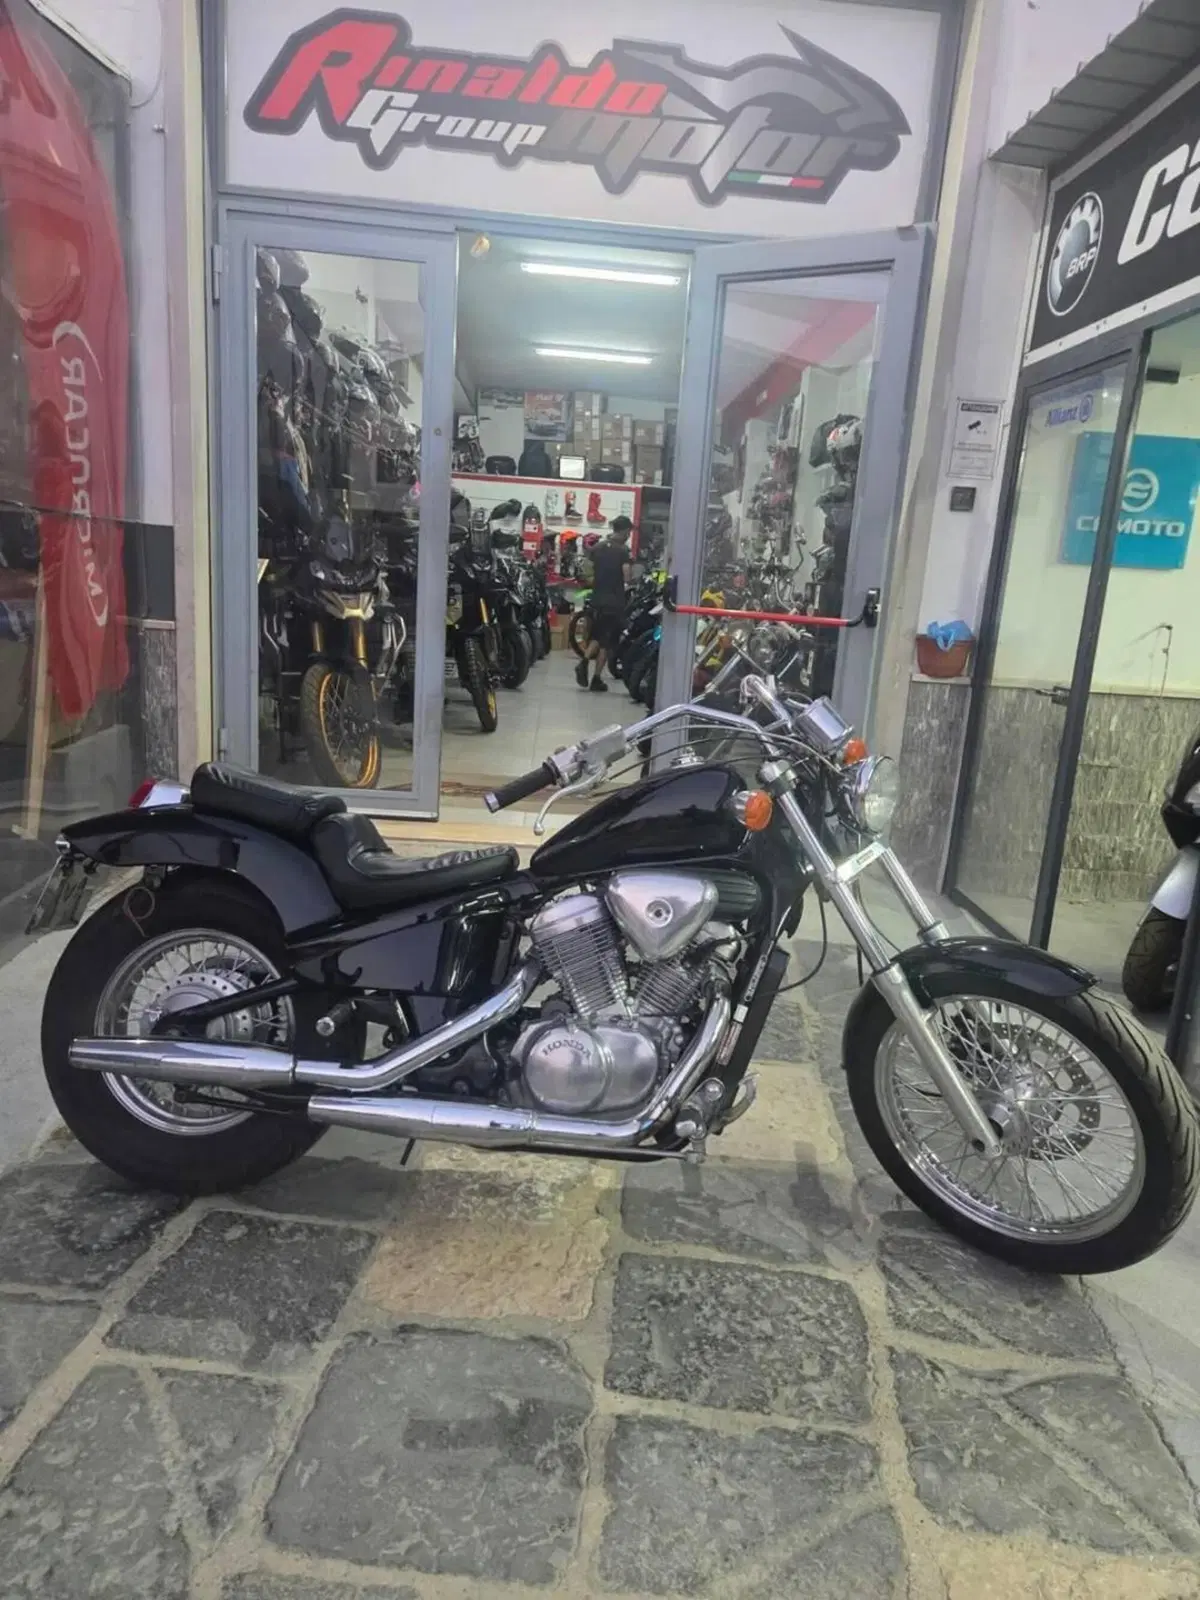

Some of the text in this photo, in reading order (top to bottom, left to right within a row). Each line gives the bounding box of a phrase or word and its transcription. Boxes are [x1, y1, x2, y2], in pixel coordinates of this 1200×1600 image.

[259, 19, 667, 125] Rinaldo
[346, 89, 547, 156] Group
[1066, 246, 1097, 279] BRP
[1076, 515, 1185, 537] CMOTO
[541, 1039, 592, 1058] HONDA
